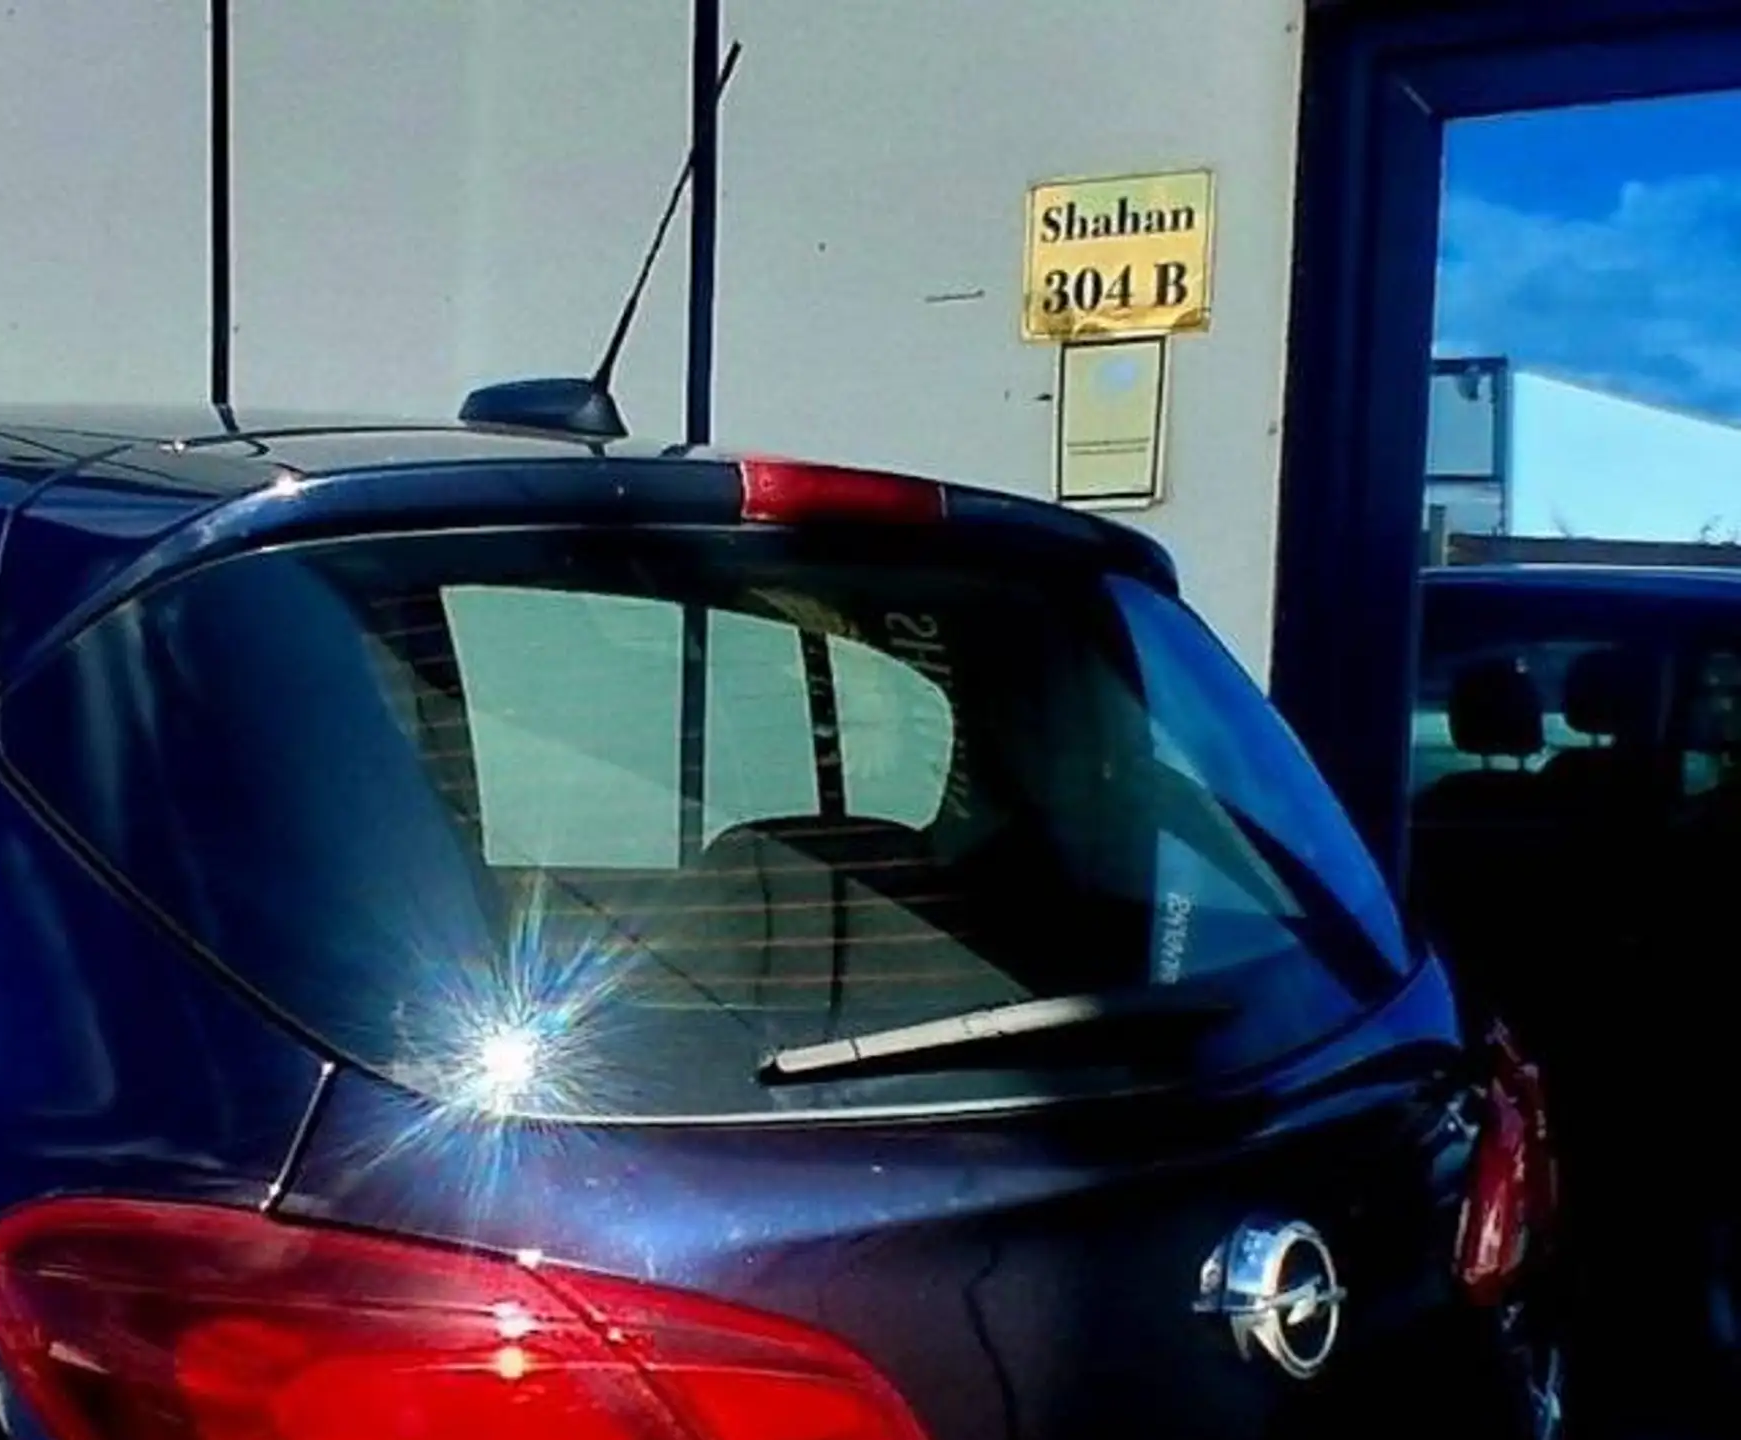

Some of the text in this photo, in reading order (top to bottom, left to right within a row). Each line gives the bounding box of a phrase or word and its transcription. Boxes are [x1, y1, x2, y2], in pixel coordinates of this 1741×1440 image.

[1040, 197, 1195, 244] Shahan
[1043, 261, 1189, 316] 304 B
